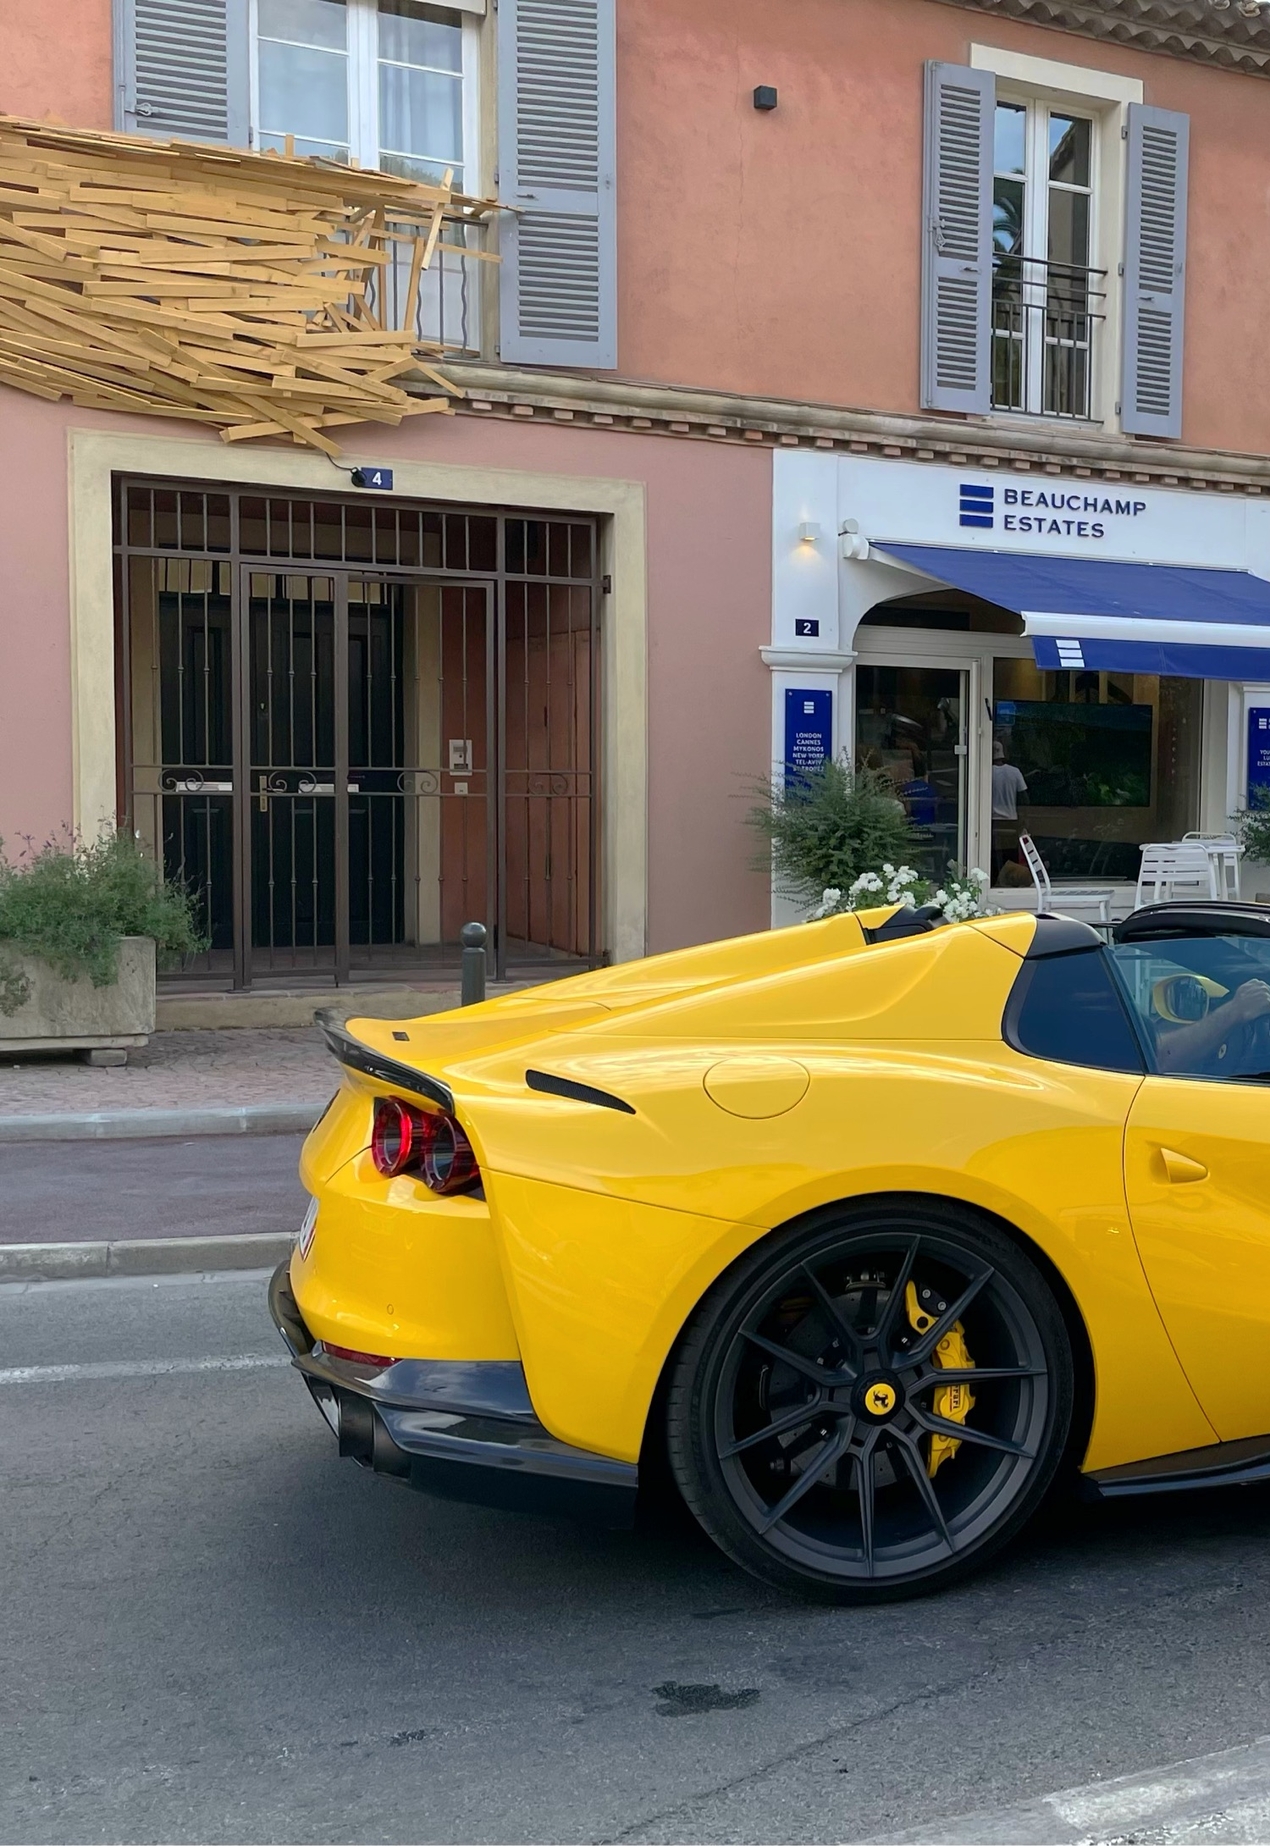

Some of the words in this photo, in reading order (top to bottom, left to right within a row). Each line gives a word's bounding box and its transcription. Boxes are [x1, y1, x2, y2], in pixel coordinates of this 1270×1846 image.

[372, 472, 382, 485] 4
[1004, 488, 1147, 516] BEAUCHAMP
[1004, 514, 1105, 538] ESTATES
[803, 622, 811, 634] 2
